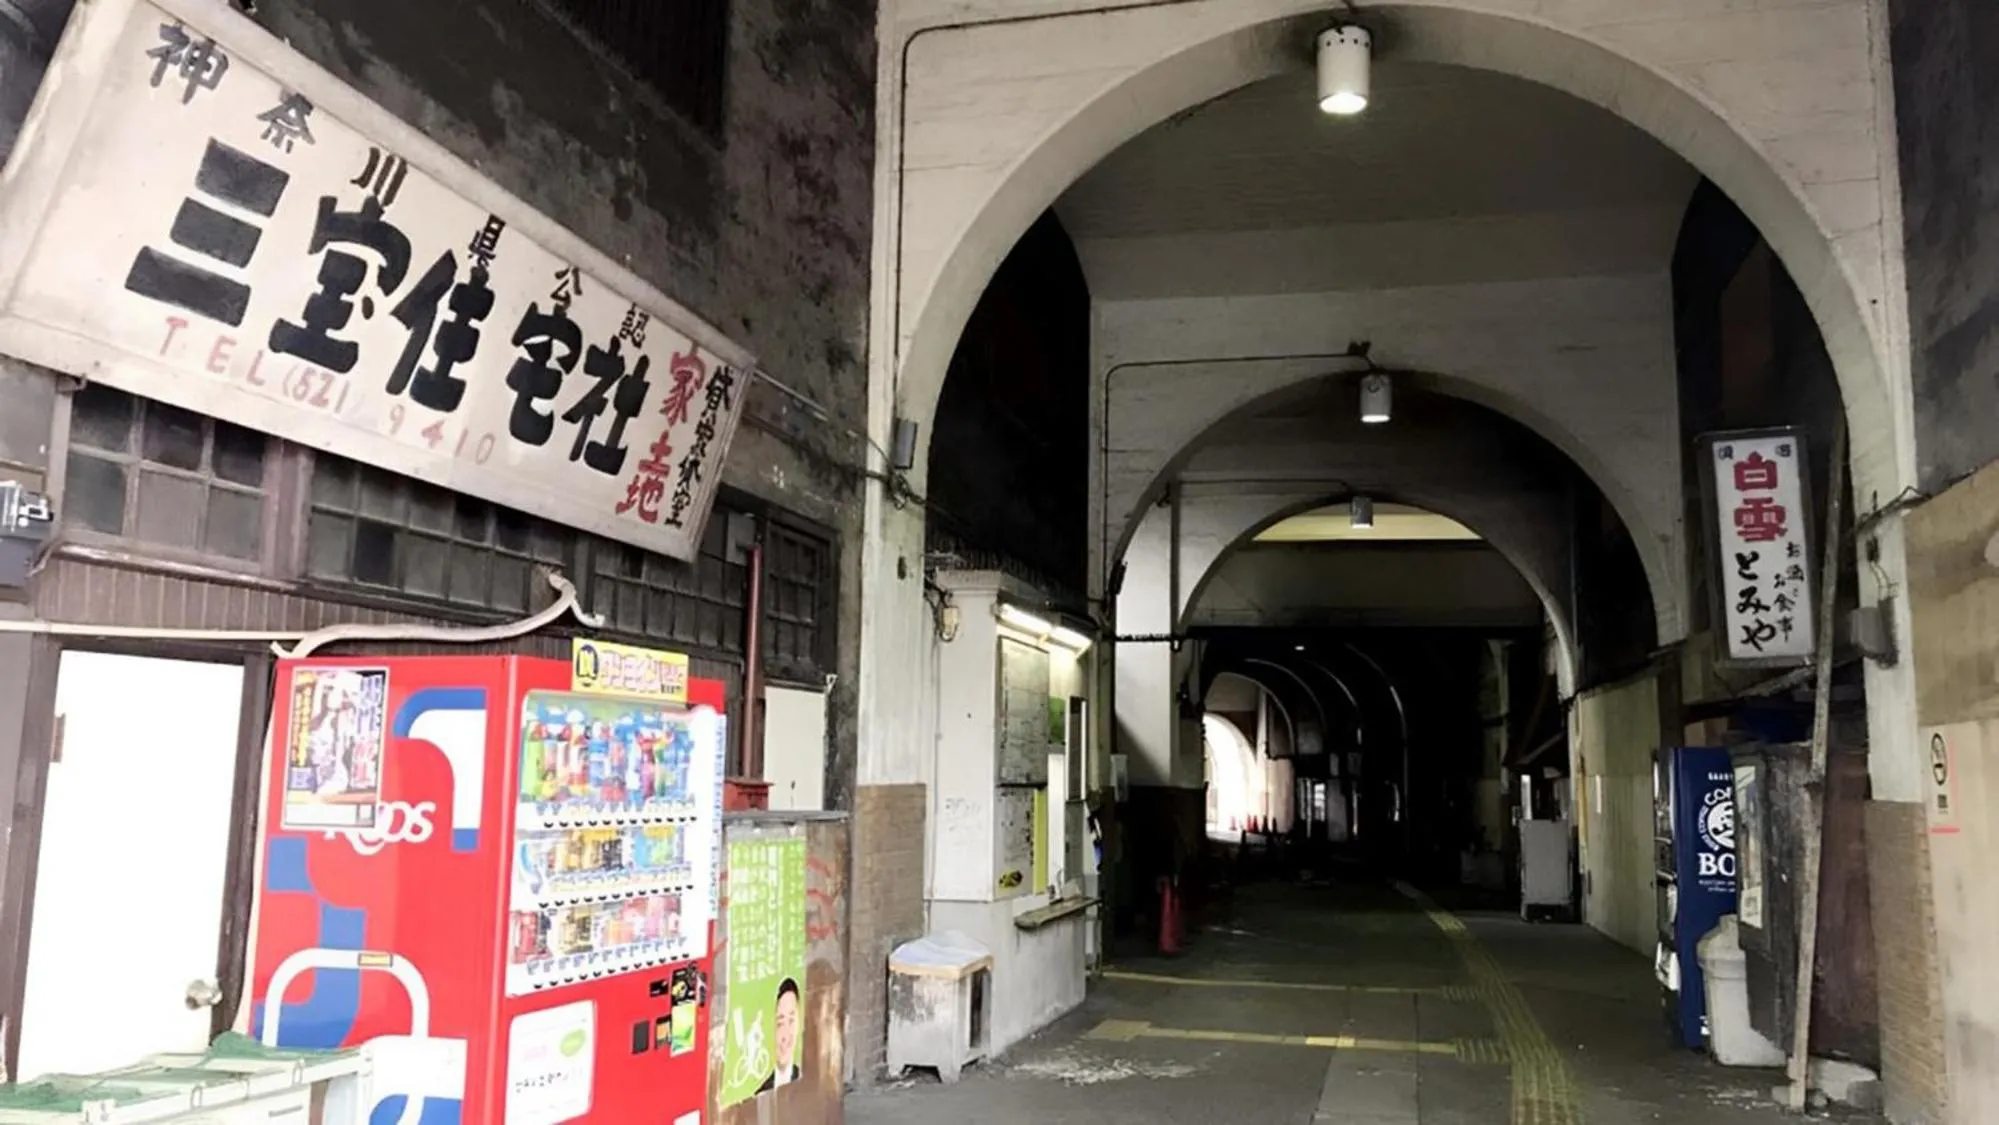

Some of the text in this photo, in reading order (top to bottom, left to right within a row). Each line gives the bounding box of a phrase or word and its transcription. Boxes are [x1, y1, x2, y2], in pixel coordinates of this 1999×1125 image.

[125, 136, 650, 476] 三宝住宅社
[1733, 451, 1788, 543] 白雪
[1735, 551, 1777, 652] とみや
